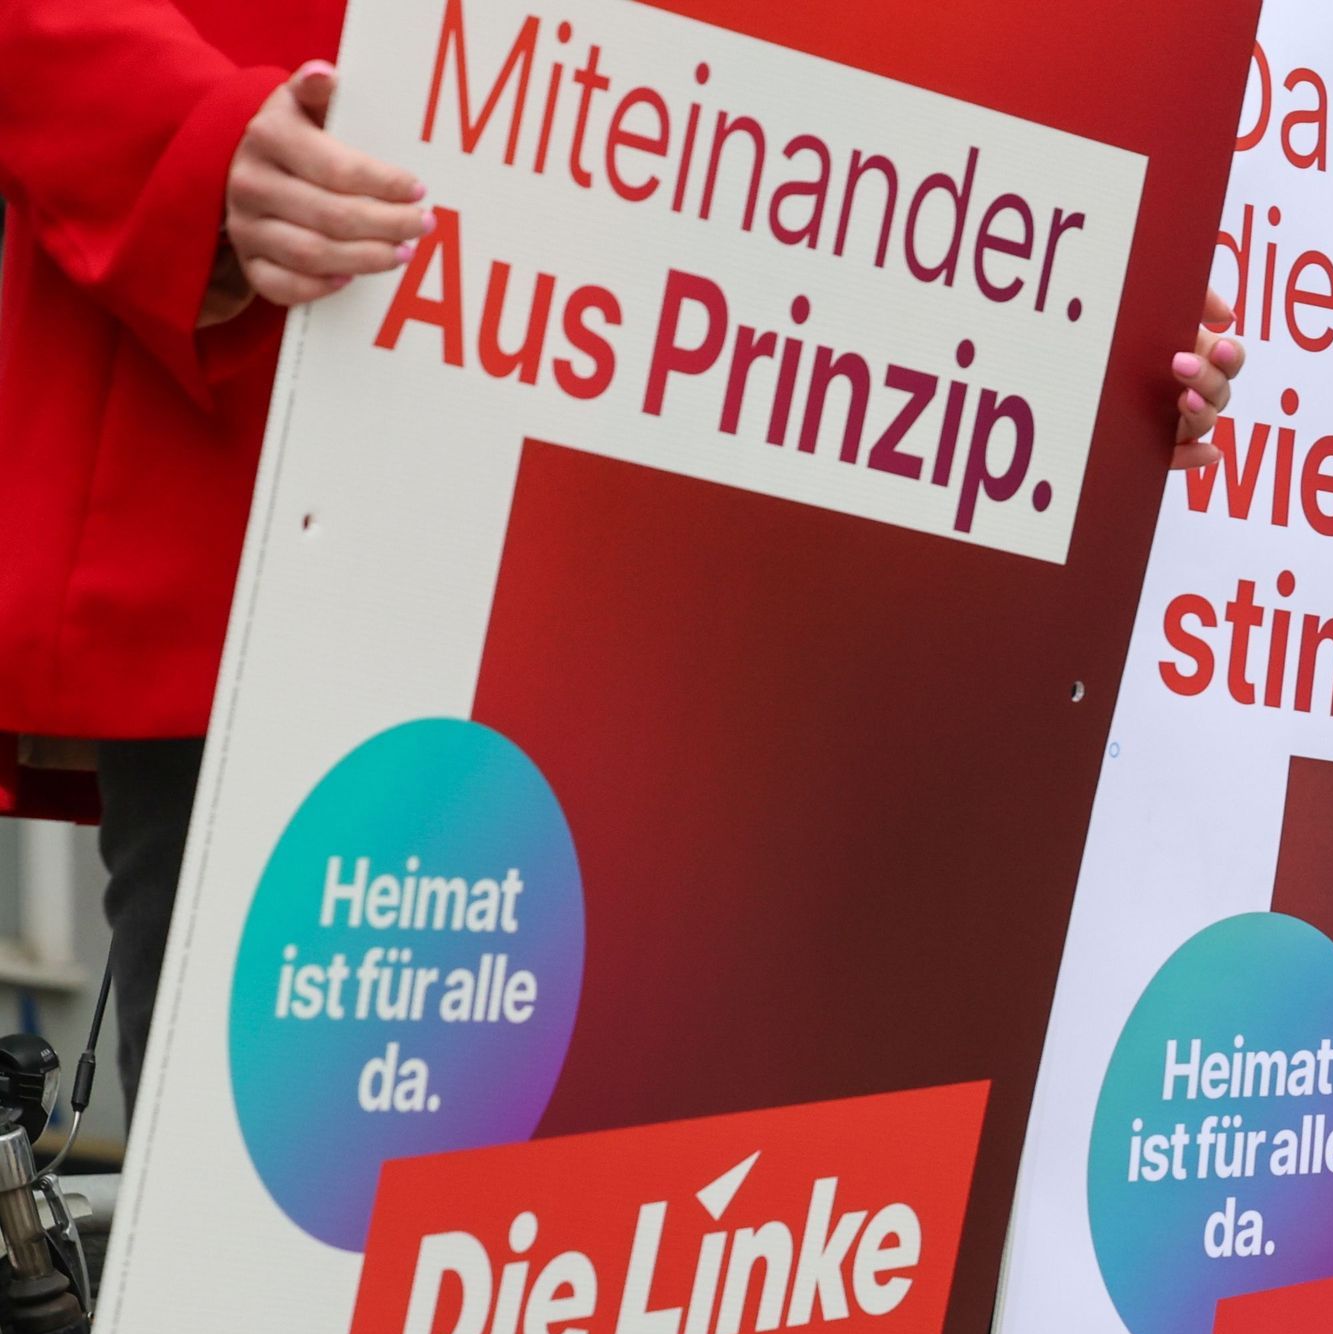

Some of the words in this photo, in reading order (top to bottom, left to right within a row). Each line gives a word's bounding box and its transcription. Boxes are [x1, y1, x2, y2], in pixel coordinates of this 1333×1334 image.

[421, 0, 1084, 324] Miteinander.
[373, 204, 623, 400] Aus
[643, 269, 1052, 533] Prinzip.
[322, 858, 523, 933] Heimat
[277, 947, 349, 1018] ist
[356, 948, 439, 1020] für
[440, 953, 538, 1024] alle
[359, 1042, 442, 1113] da.
[1129, 1119, 1189, 1181] ist
[1197, 1115, 1266, 1178] für
[1204, 1197, 1275, 1258] da.
